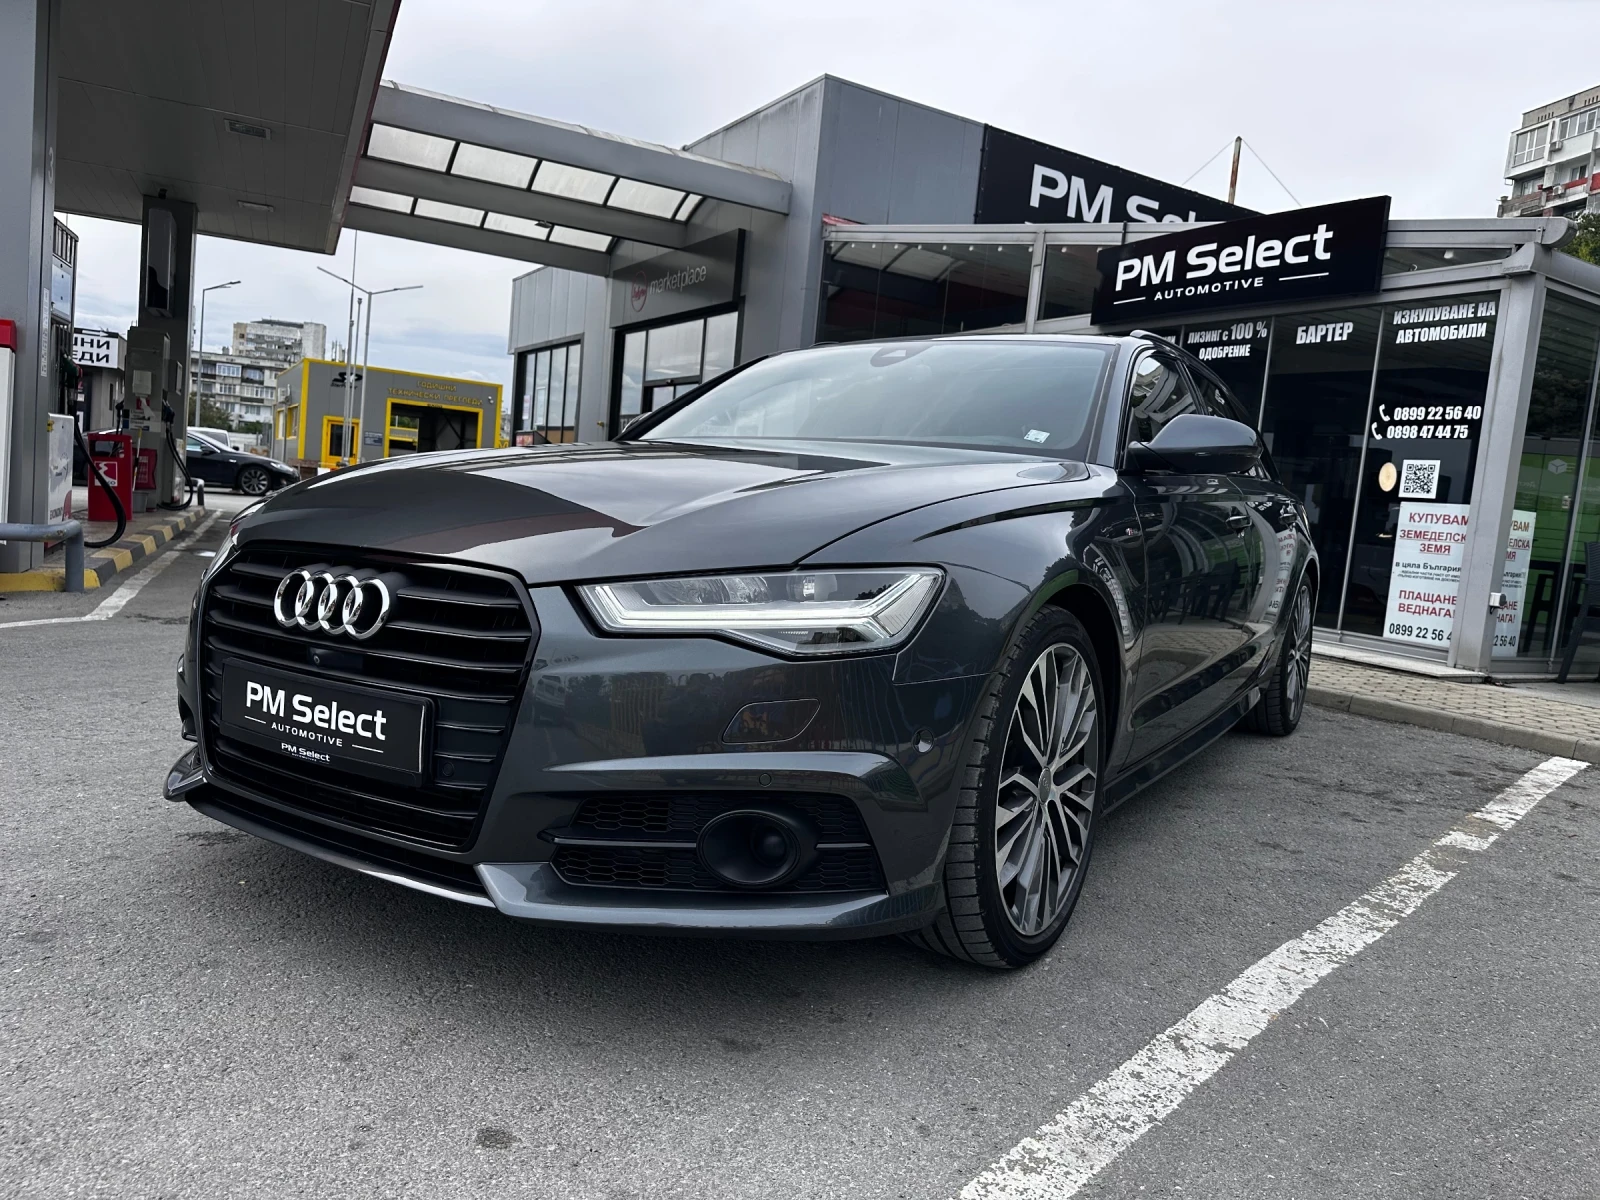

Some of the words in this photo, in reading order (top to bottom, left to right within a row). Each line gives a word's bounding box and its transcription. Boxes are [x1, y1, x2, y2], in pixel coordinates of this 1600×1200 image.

[1029, 163, 1113, 224] PM
[1115, 250, 1176, 291] PM
[1186, 224, 1333, 279] Select
[649, 266, 707, 294] marketplace
[1154, 277, 1264, 300] AUTOMOTIVE
[1393, 304, 1476, 324] ИЗКУПУВАНЕ
[1476, 302, 1496, 317] НА
[1188, 330, 1222, 344] ЛИЗИНГ
[1230, 322, 1253, 340] 100
[1256, 320, 1268, 338] %
[1296, 322, 1354, 344] БАРТЕР
[1396, 322, 1487, 344] АВТОМОБИЛИ
[1199, 344, 1251, 360] ОДОБРЕНИЕ
[1394, 407, 1426, 420] 0899
[1427, 406, 1444, 420] 22
[1445, 406, 1462, 420] 56
[1464, 406, 1482, 420] 40
[1387, 425, 1418, 439] 0898
[1419, 425, 1434, 438] 47
[1435, 425, 1451, 438] 44
[1453, 425, 1468, 438] 75
[1409, 512, 1469, 526] КУПУВАМ
[1400, 529, 1466, 542] ЗЕМЕДЕЛСК
[1509, 539, 1530, 549] ЕЛСКА
[1420, 543, 1451, 554] ЗЕМЯ
[1399, 590, 1457, 605] ПЛАЩАНЕ
[1389, 623, 1413, 637] 0899
[1415, 626, 1428, 639] 22
[1431, 629, 1444, 641] 56
[1508, 635, 1516, 647] 40
[246, 680, 285, 717] PM
[292, 693, 387, 741] Select
[271, 722, 343, 747] AUTOMOTIVE
[281, 742, 297, 753] PM
[299, 747, 330, 762] Select
